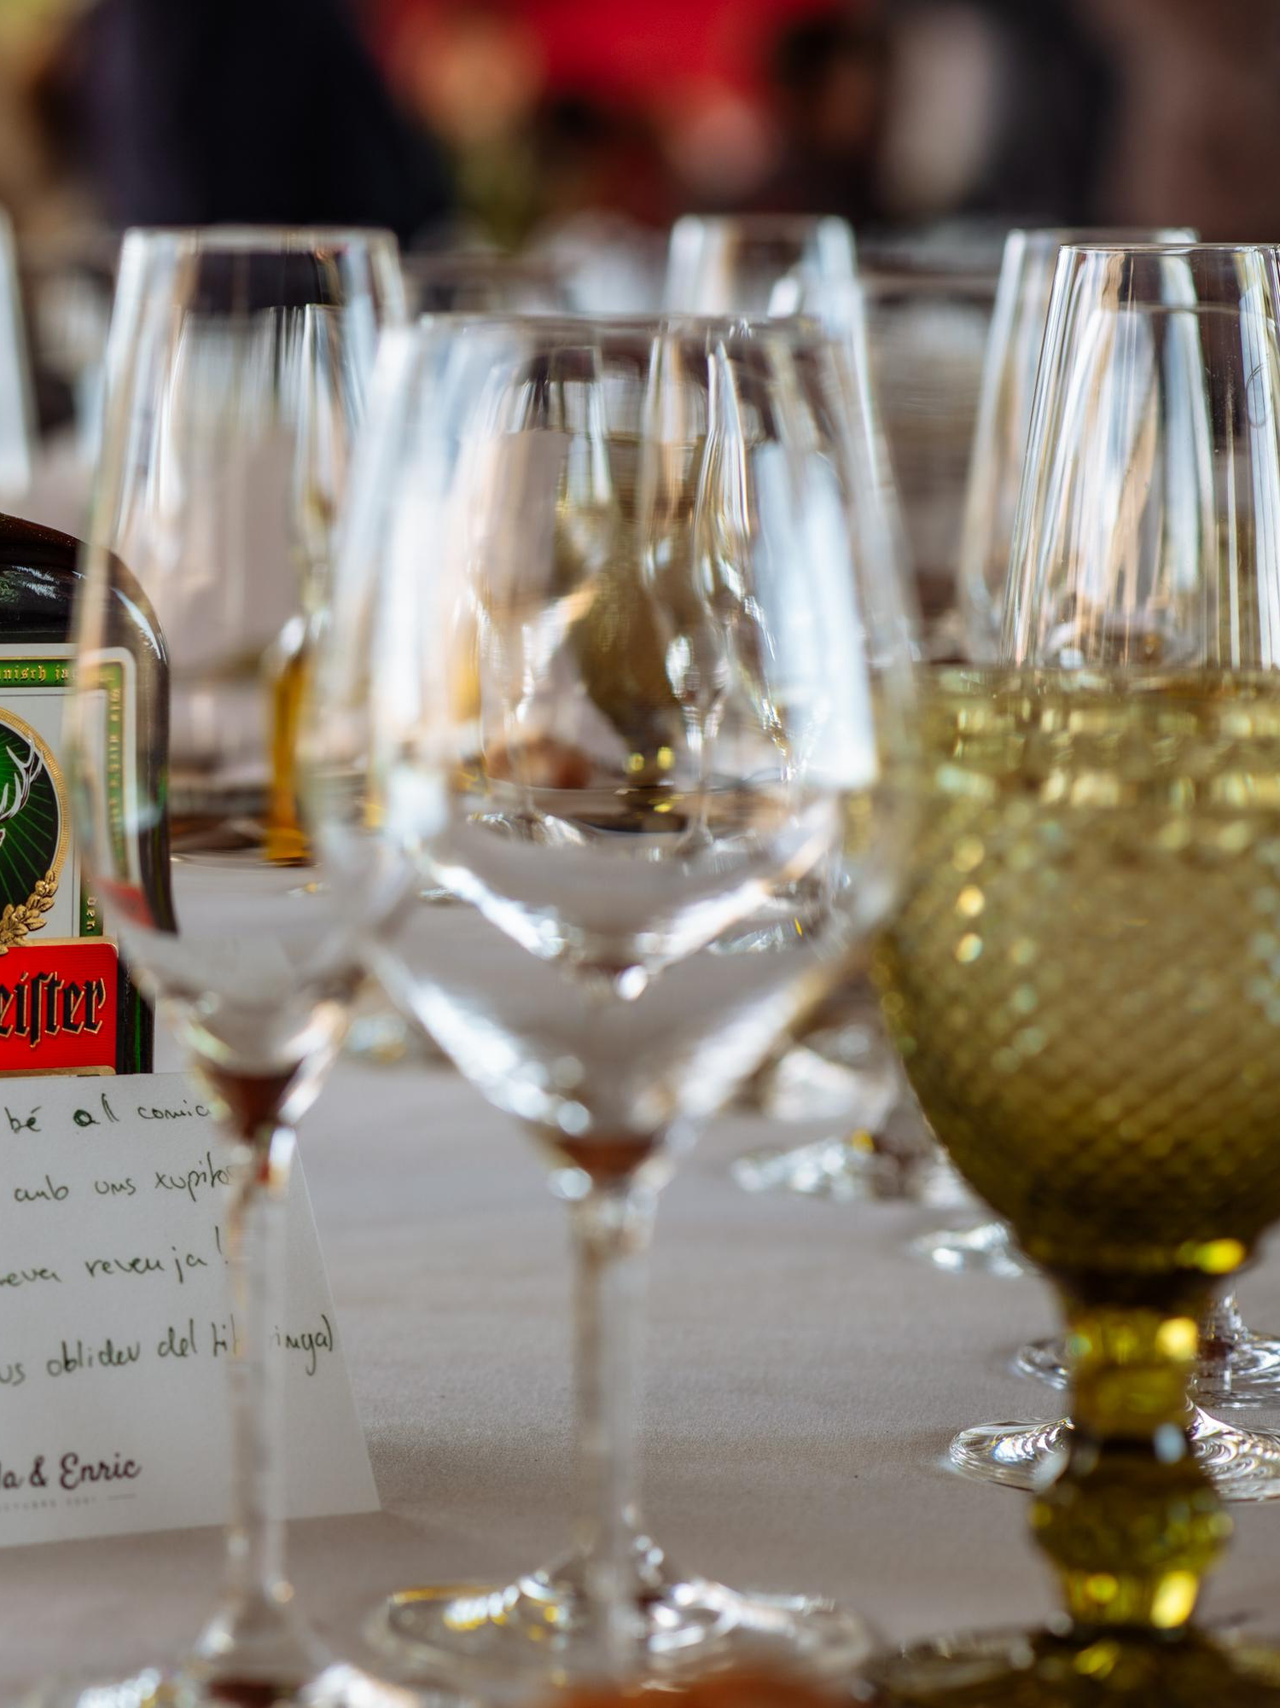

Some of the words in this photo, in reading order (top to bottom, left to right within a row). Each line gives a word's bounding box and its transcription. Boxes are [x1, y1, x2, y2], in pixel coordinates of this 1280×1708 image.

[4, 1106, 43, 1133] bé
[94, 1177, 137, 1196] uns
[155, 1151, 234, 1203] xupito
[157, 1317, 198, 1359] del
[29, 1455, 48, 1488] &
[58, 1452, 142, 1490] Enric
